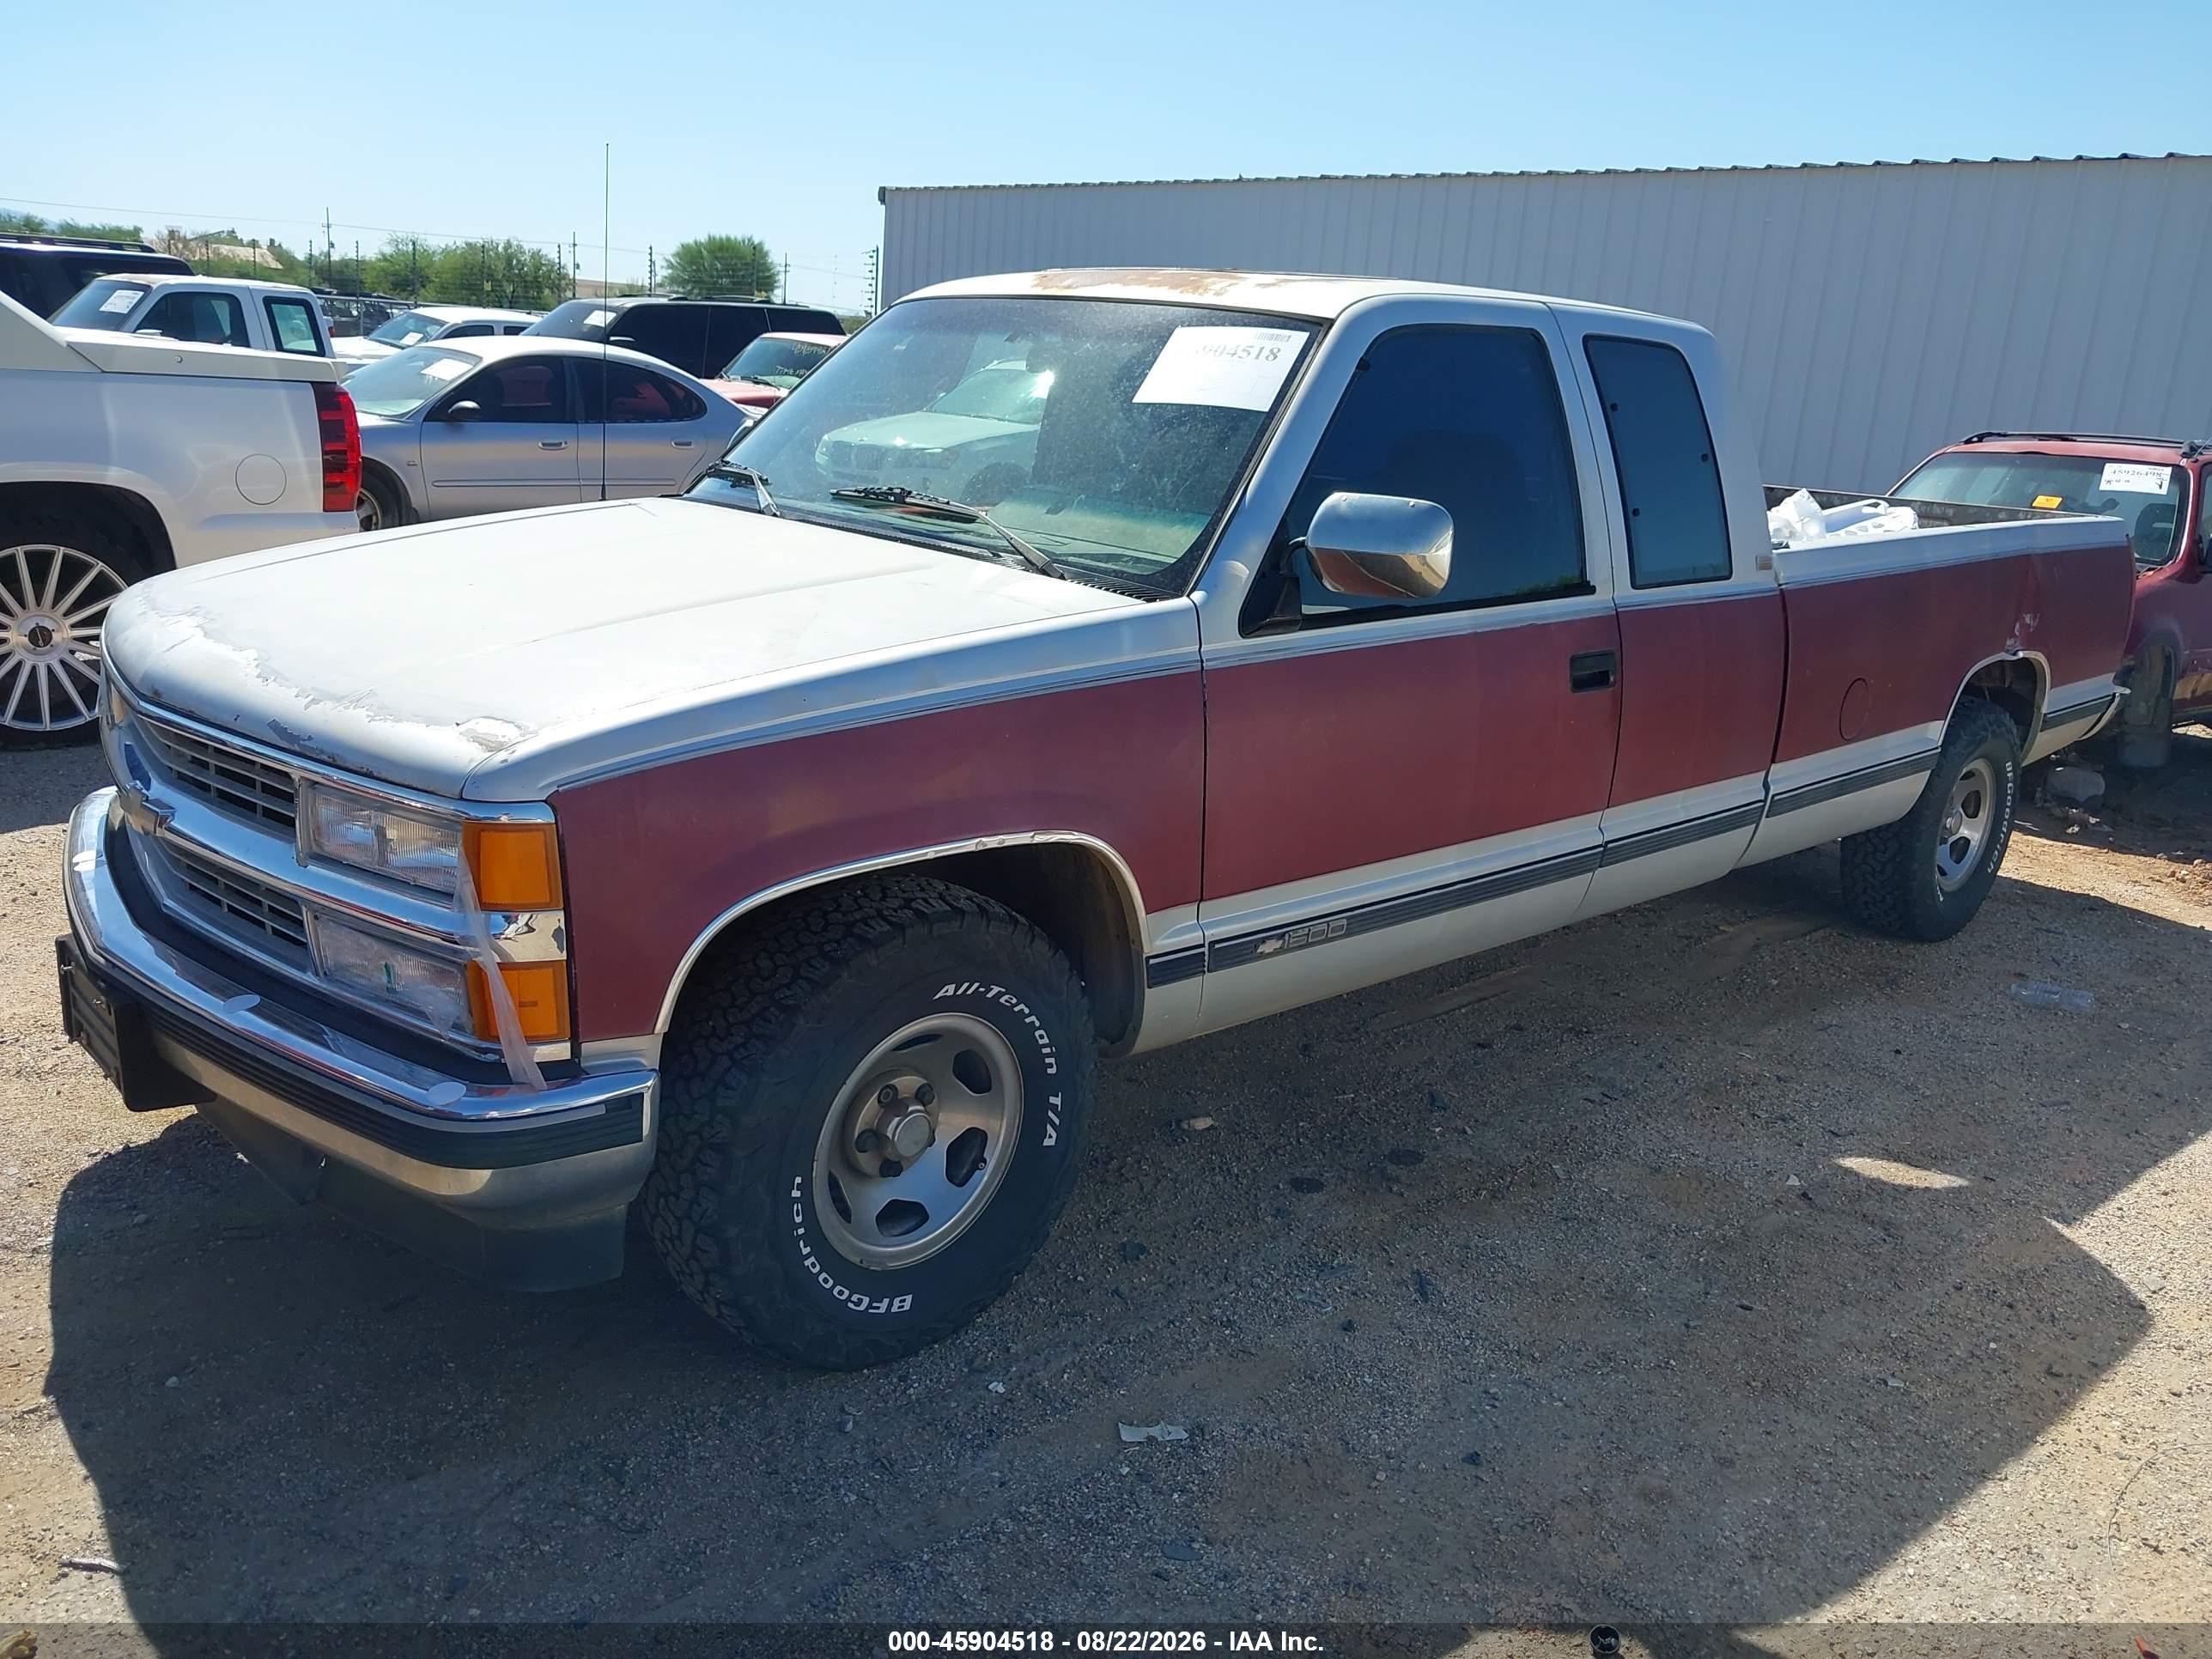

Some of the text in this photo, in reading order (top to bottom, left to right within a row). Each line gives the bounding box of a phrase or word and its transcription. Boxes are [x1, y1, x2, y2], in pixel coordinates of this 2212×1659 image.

[1986, 761, 2014, 873] BFGoodrich
[933, 981, 1062, 1147] All-Terrain T/A
[790, 1176, 914, 1314] BFGoodrich
